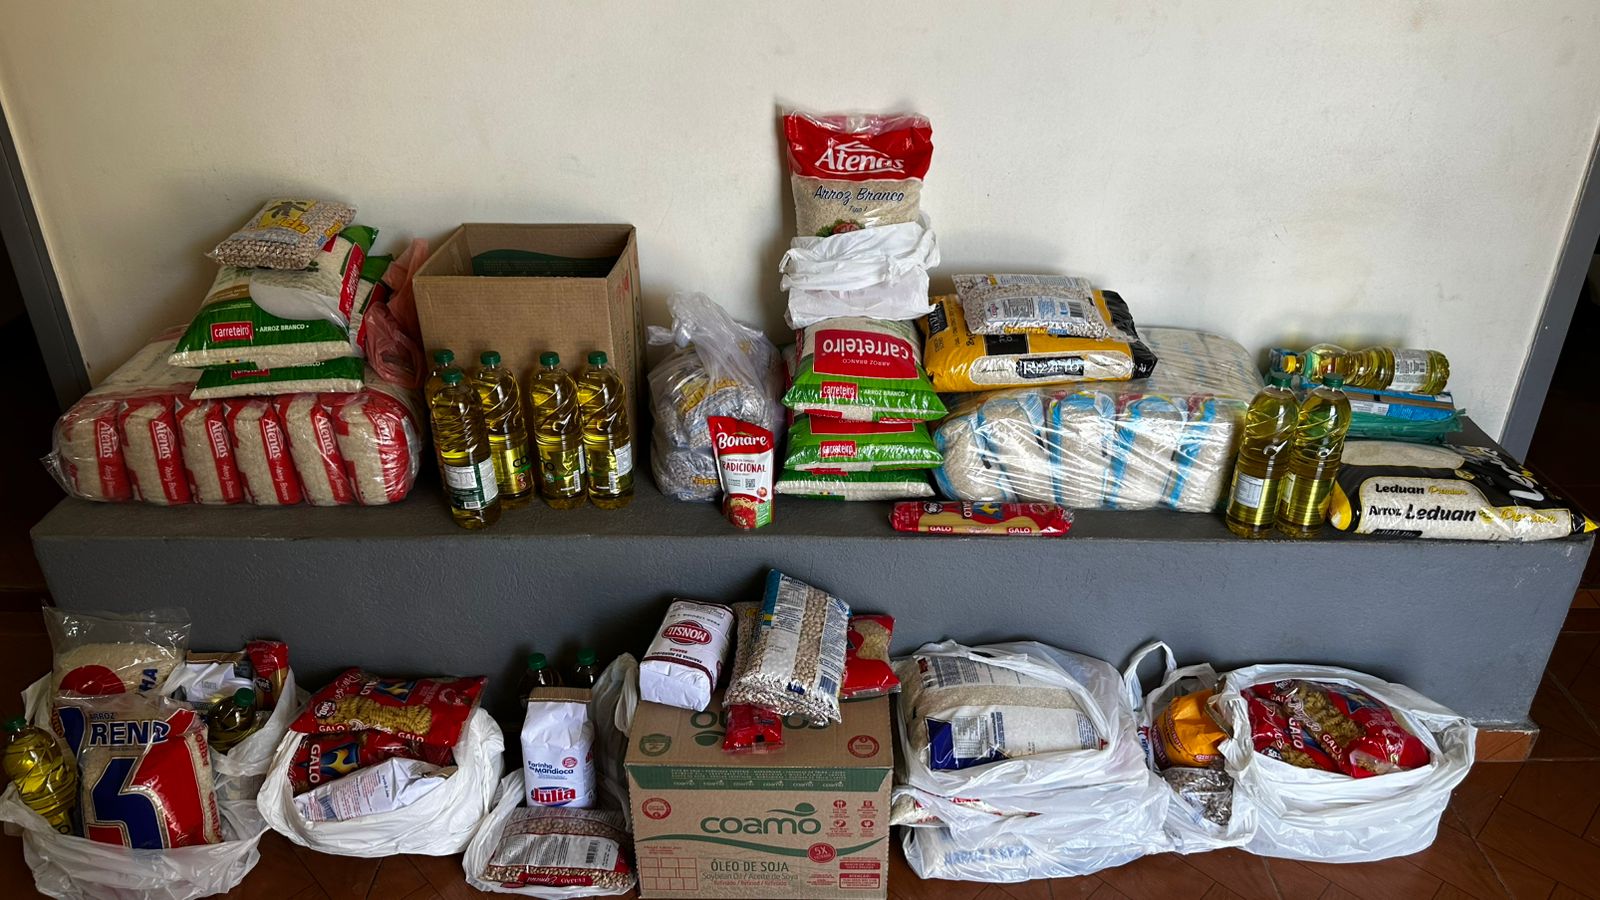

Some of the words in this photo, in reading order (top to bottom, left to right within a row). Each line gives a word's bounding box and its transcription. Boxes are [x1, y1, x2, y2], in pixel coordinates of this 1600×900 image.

[814, 138, 905, 173] Atenas
[814, 185, 852, 205] Arroz
[856, 187, 905, 202] Branco
[214, 325, 250, 338] carreteiro
[281, 324, 305, 332] BRANCO
[823, 338, 909, 359] carreteiro
[823, 385, 855, 396] carreteiro
[152, 421, 171, 460] Atenas
[209, 421, 228, 458] Atenas
[263, 419, 282, 459] Atenas
[316, 416, 335, 456] Atenas
[716, 432, 768, 449] Bonare
[722, 461, 767, 473] RADICIONAL
[1375, 483, 1425, 495] Leduan
[1369, 505, 1401, 516] Arroz
[1405, 504, 1476, 522] Leduan
[666, 626, 708, 642] MONSIL
[398, 733, 424, 743] GALO
[1288, 717, 1304, 749] GALO
[309, 744, 321, 783] GALO
[528, 761, 553, 769] Farinha
[700, 816, 822, 835] coamo
[814, 847, 828, 856] 5X
[711, 858, 740, 872] ÓLEO
[744, 861, 757, 872] DE
[760, 861, 789, 873] SOJA
